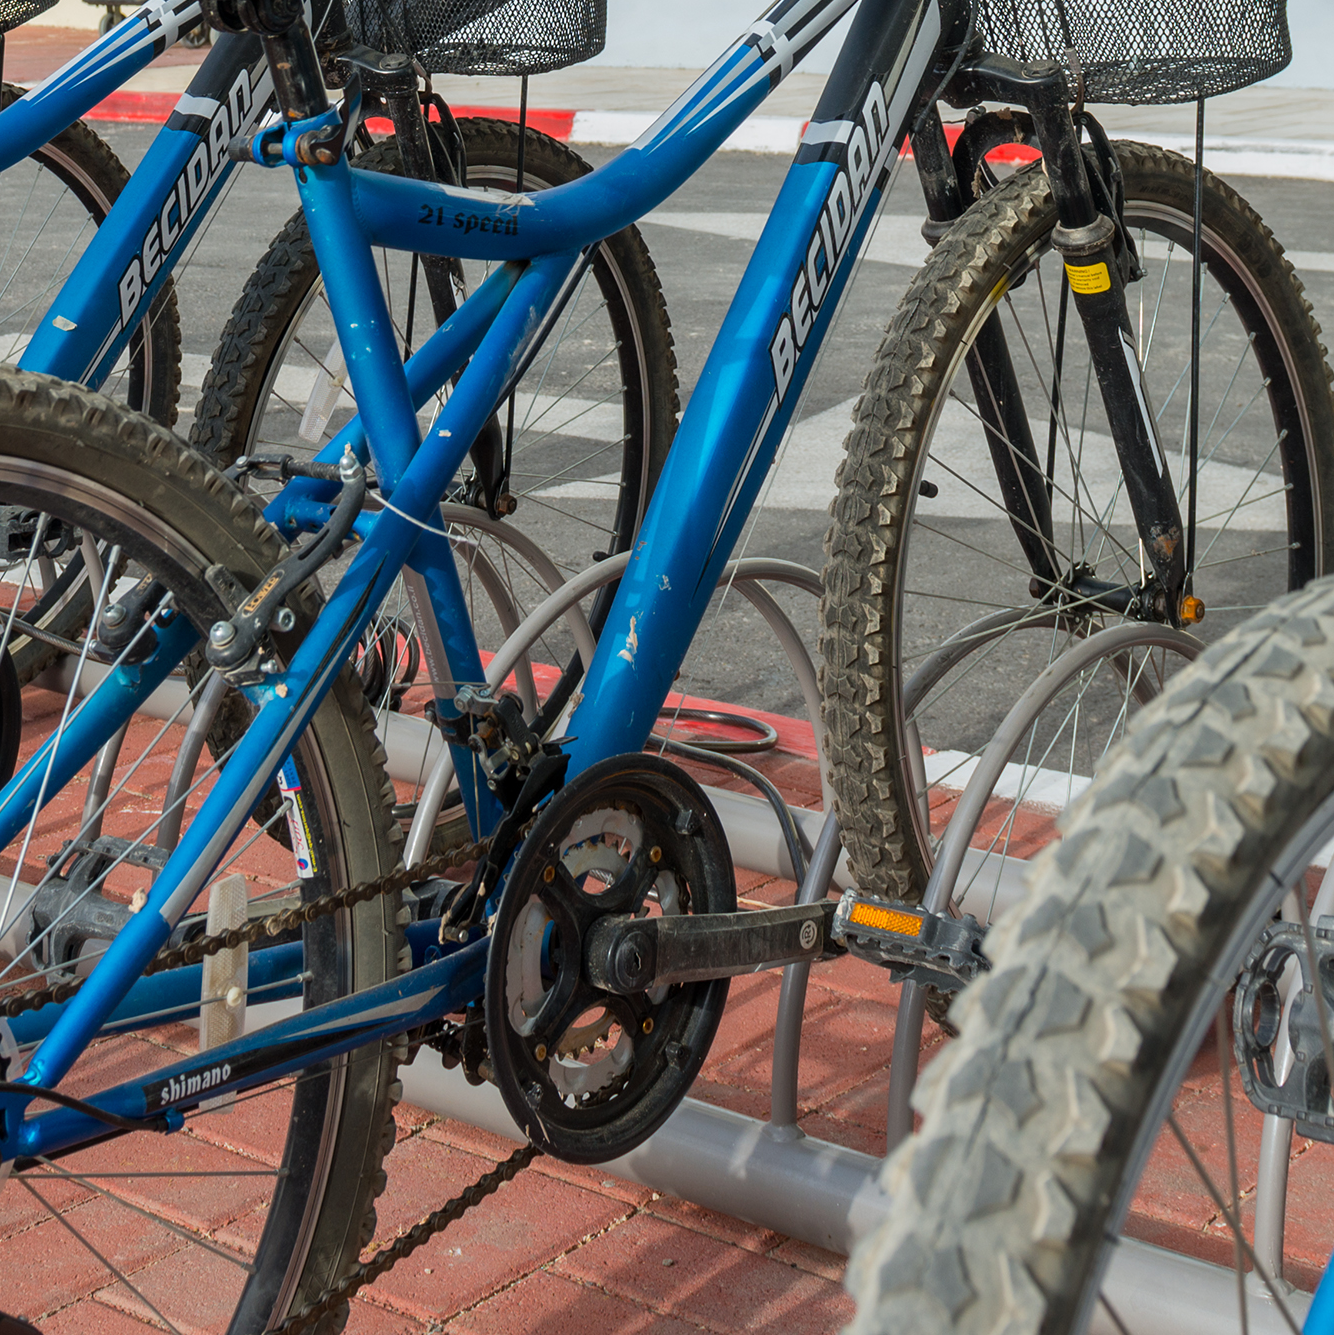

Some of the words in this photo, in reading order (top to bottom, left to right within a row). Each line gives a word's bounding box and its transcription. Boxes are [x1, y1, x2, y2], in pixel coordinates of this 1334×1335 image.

[119, 68, 253, 328] BECIDAN
[418, 204, 445, 226] 21
[453, 212, 519, 236] speed
[769, 79, 890, 409] BECIDAN
[161, 1063, 231, 1105] shimano
